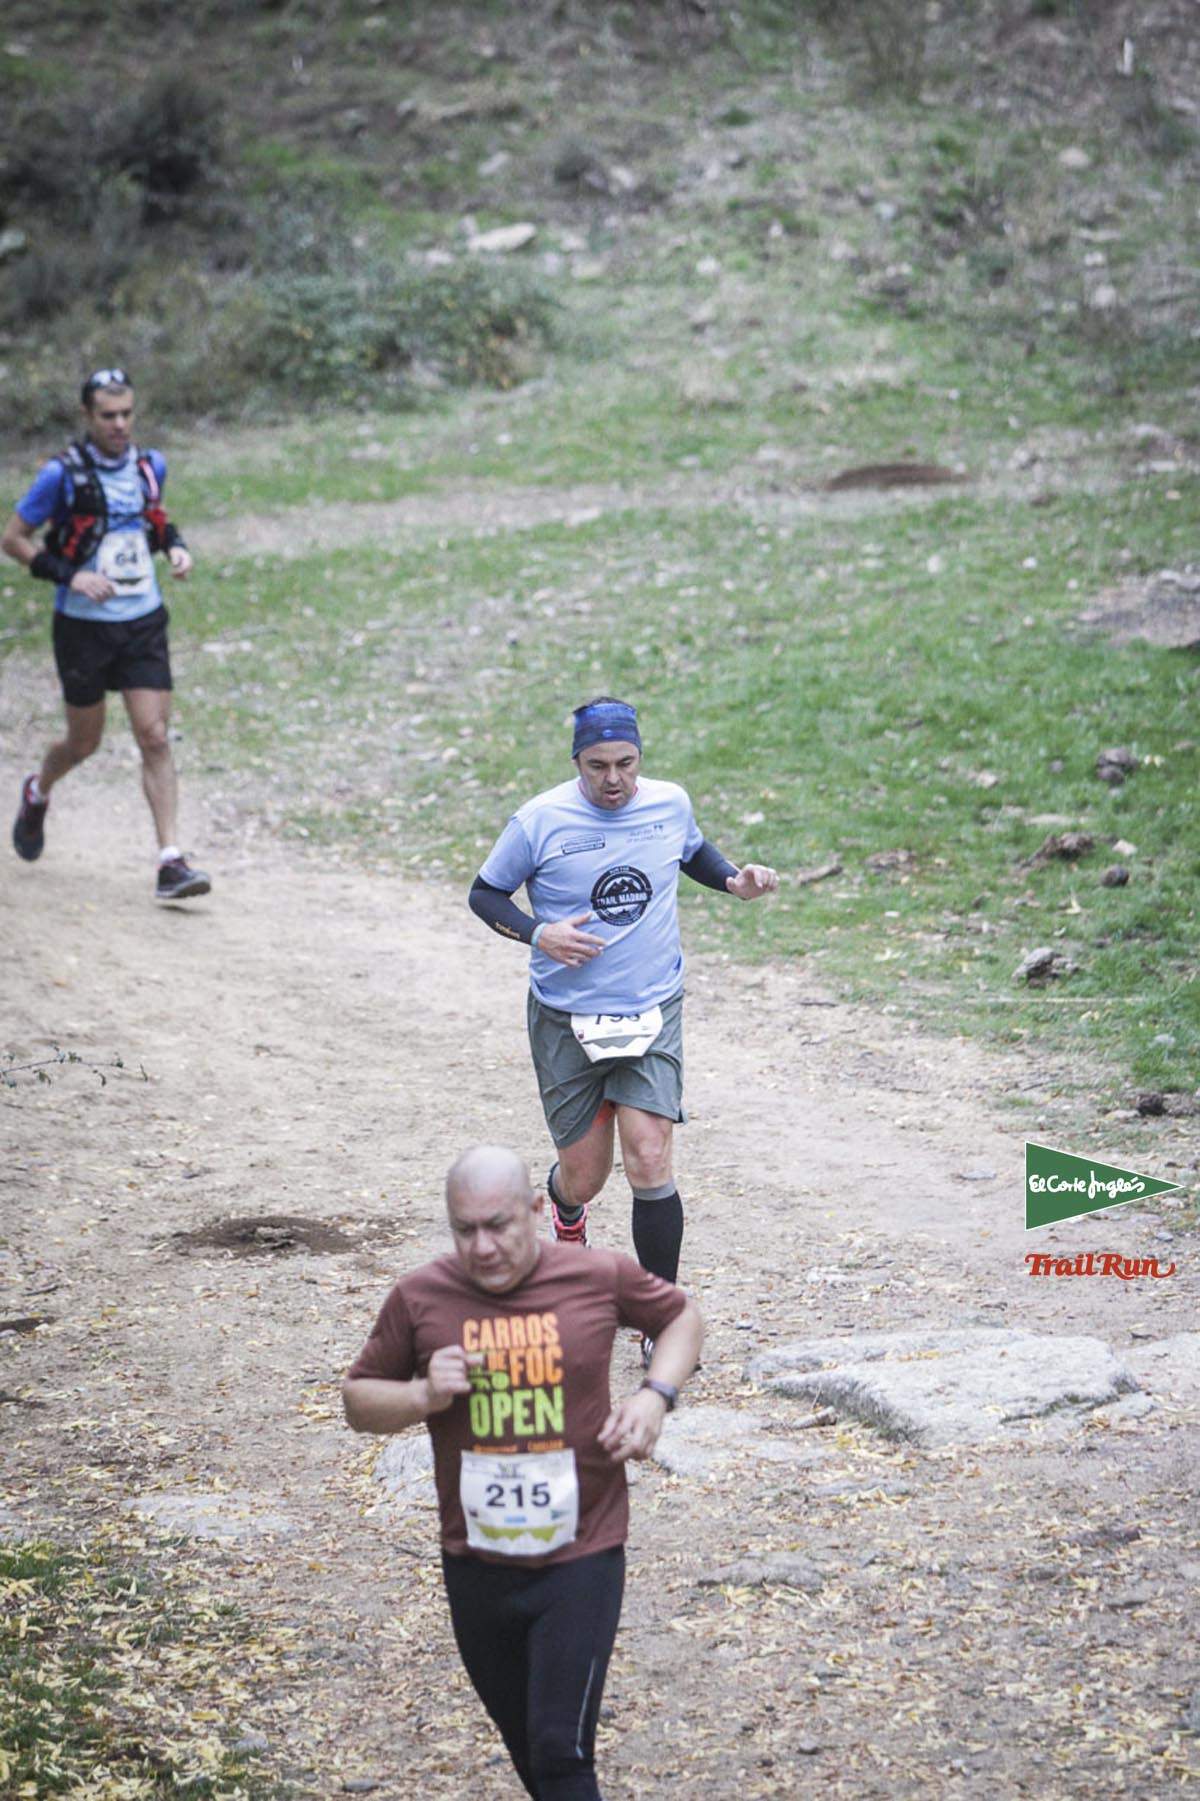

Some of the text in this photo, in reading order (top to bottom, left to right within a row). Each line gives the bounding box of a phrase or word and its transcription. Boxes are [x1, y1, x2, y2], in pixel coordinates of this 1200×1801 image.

[596, 892, 648, 907] TRAIL MADRID
[463, 1312, 560, 1352] CARROS
[509, 1345, 564, 1387] FOC
[469, 1385, 565, 1438] OPEN
[485, 1482, 551, 1508] 215
